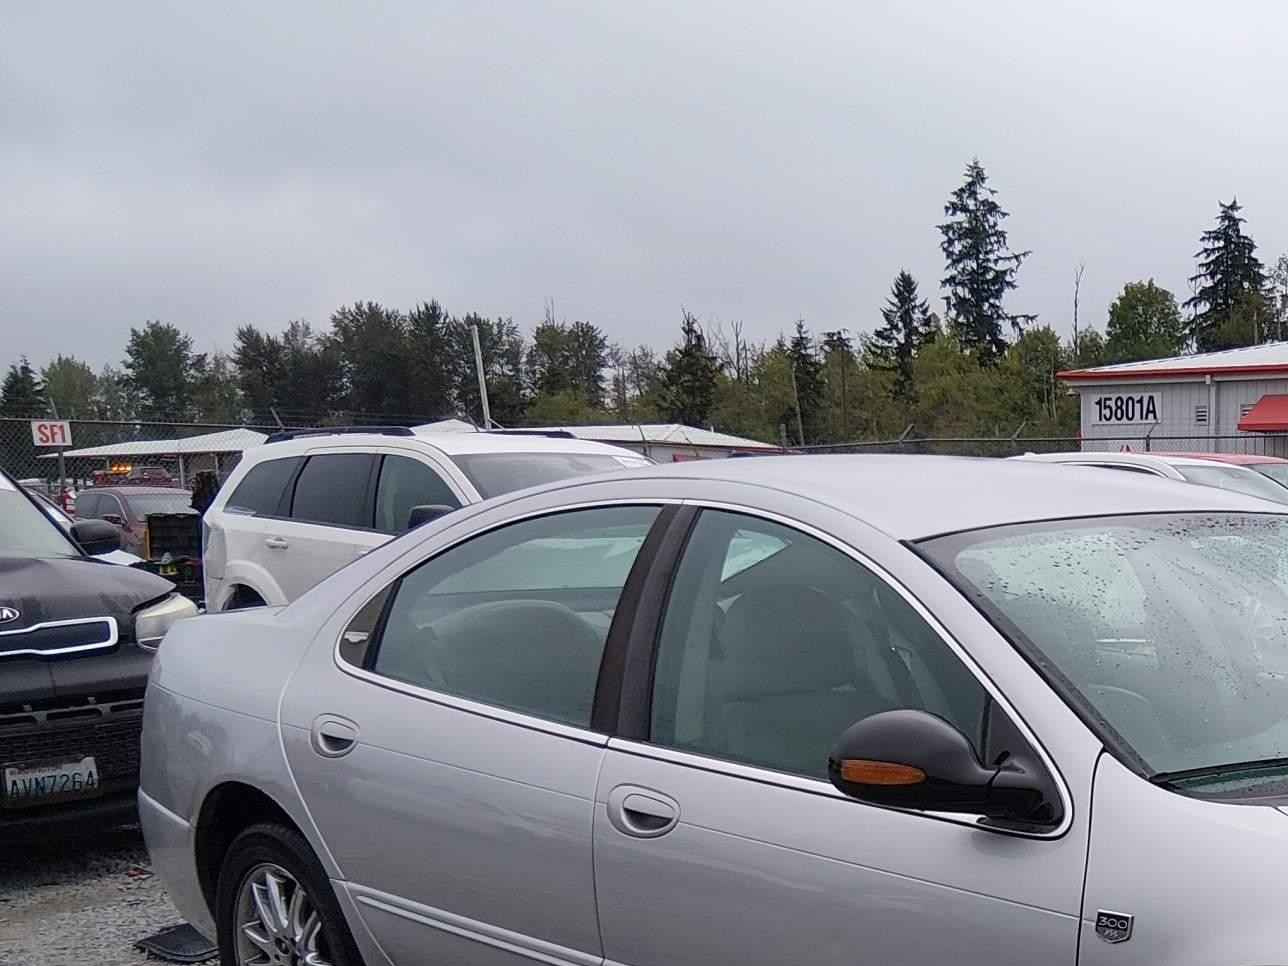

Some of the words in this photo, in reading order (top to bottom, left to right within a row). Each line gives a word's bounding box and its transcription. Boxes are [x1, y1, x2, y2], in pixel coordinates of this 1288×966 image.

[1094, 395, 1158, 421] 15801A
[37, 423, 66, 444] SF1
[1098, 916, 1128, 929] 300
